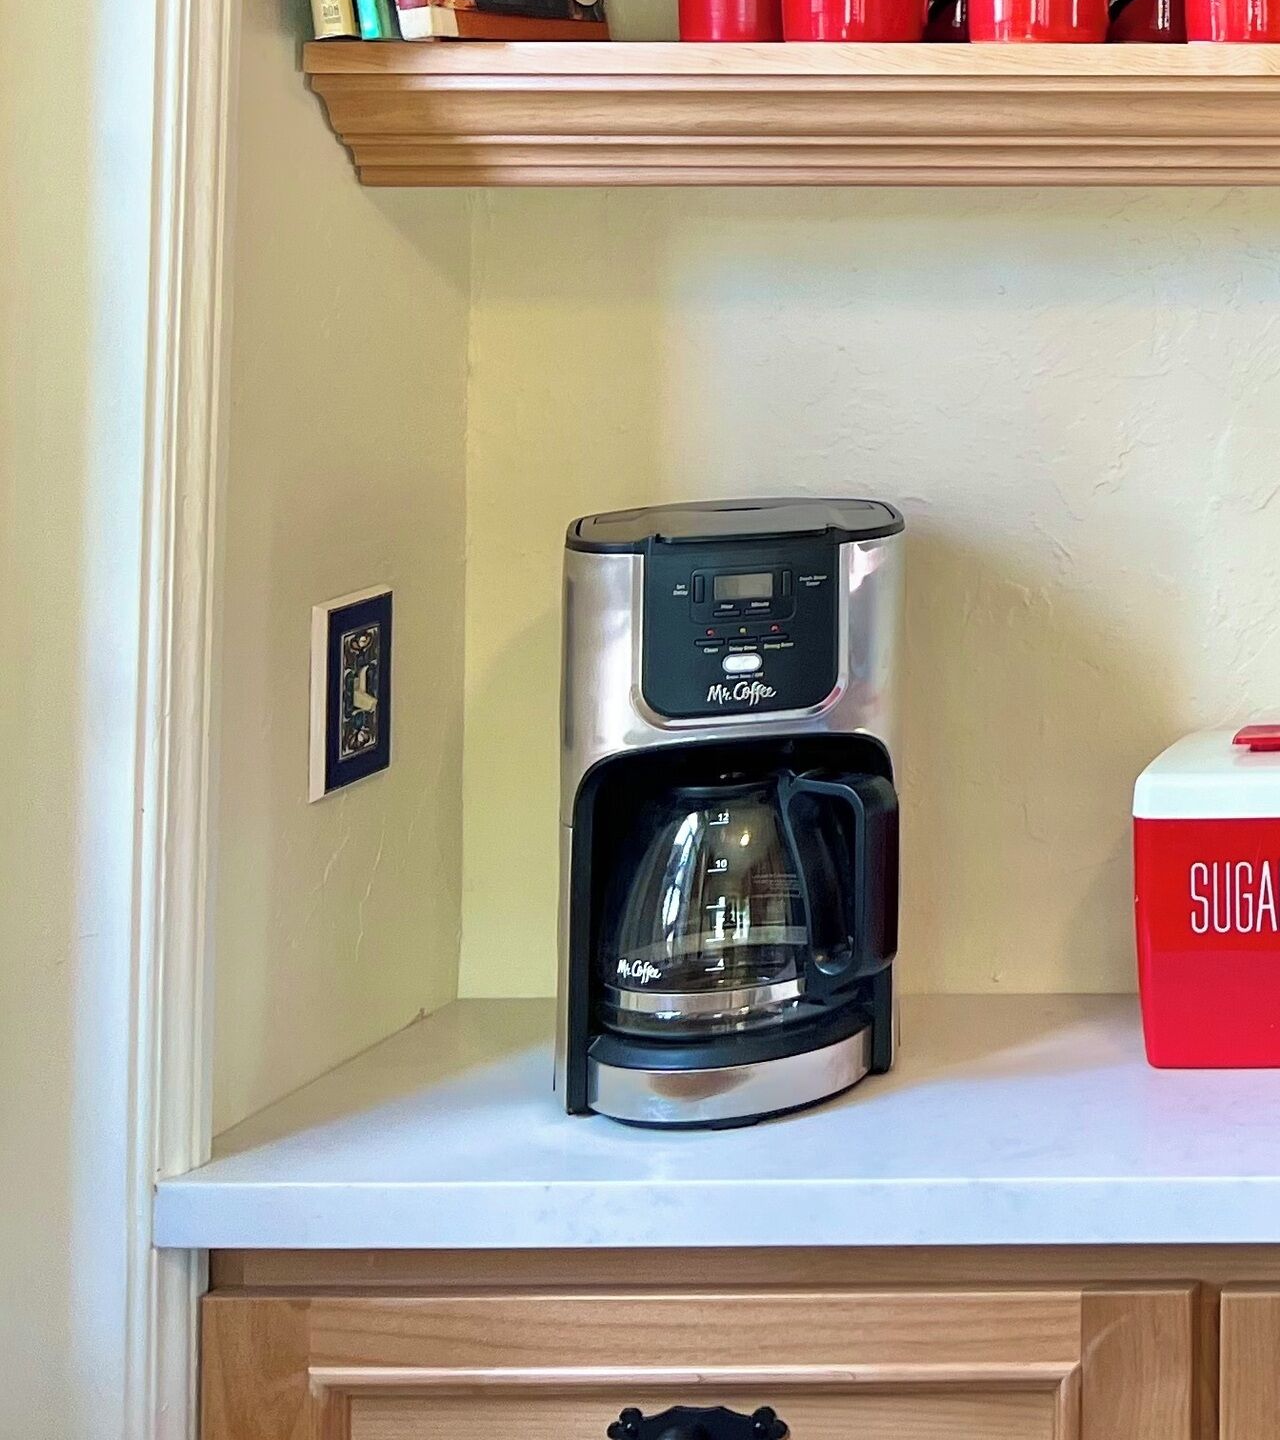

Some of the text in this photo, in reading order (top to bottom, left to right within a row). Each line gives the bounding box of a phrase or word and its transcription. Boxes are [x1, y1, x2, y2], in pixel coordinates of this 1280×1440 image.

[706, 681, 776, 706] Mr. Coffee
[718, 813, 730, 822] 12
[716, 859, 728, 868] 10
[632, 960, 662, 984] Coffee
